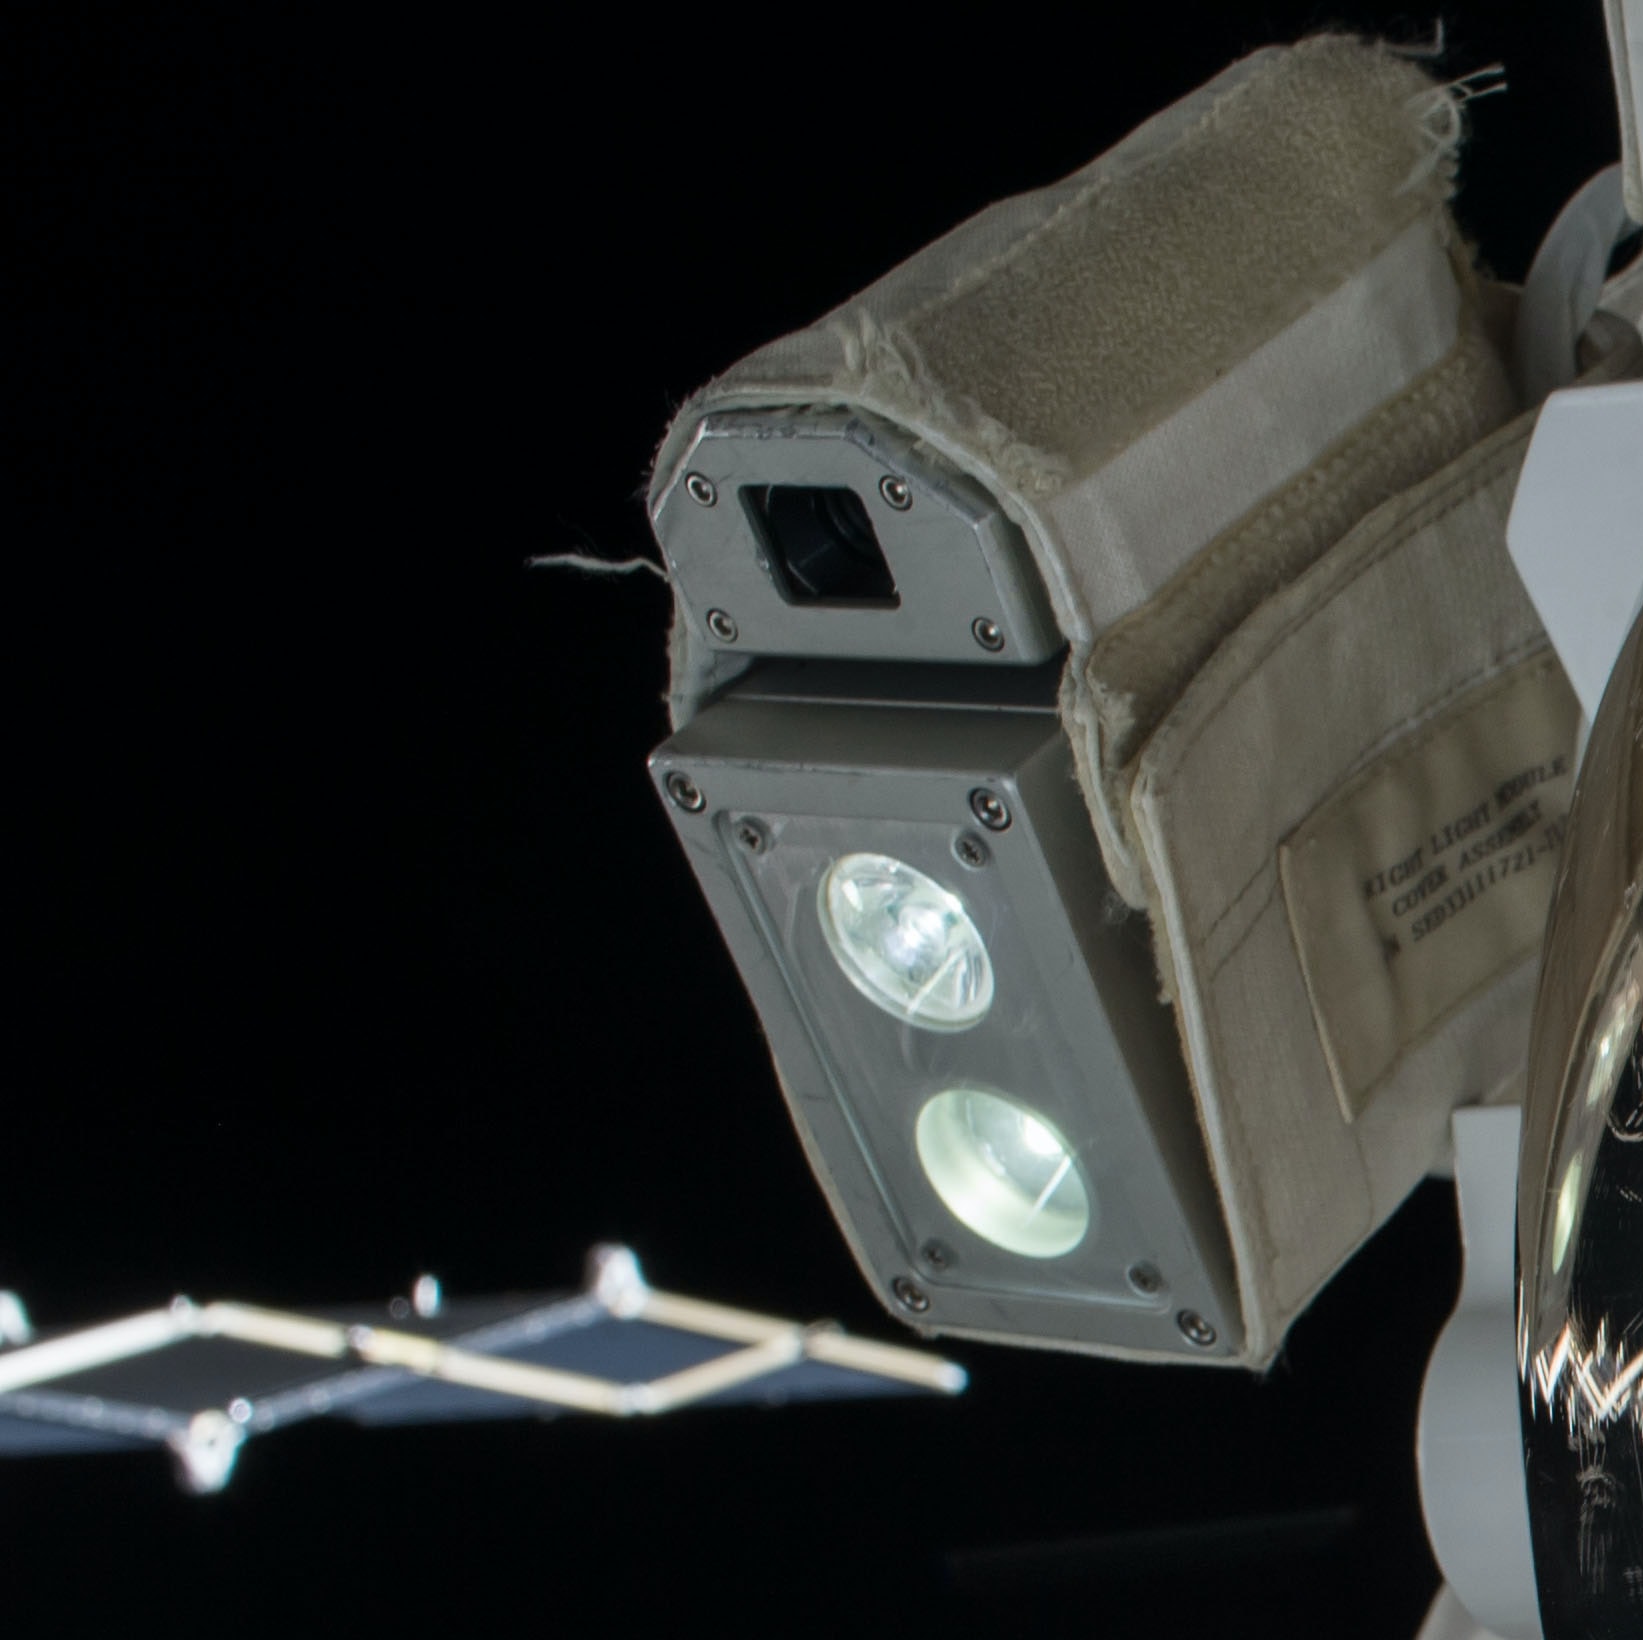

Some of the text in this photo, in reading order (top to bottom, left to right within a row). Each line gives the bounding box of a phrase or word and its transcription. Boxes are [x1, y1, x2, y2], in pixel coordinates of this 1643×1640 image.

[1392, 800, 1544, 918] COVER ASSEMBLY
[1430, 800, 1492, 855] LIGHT
